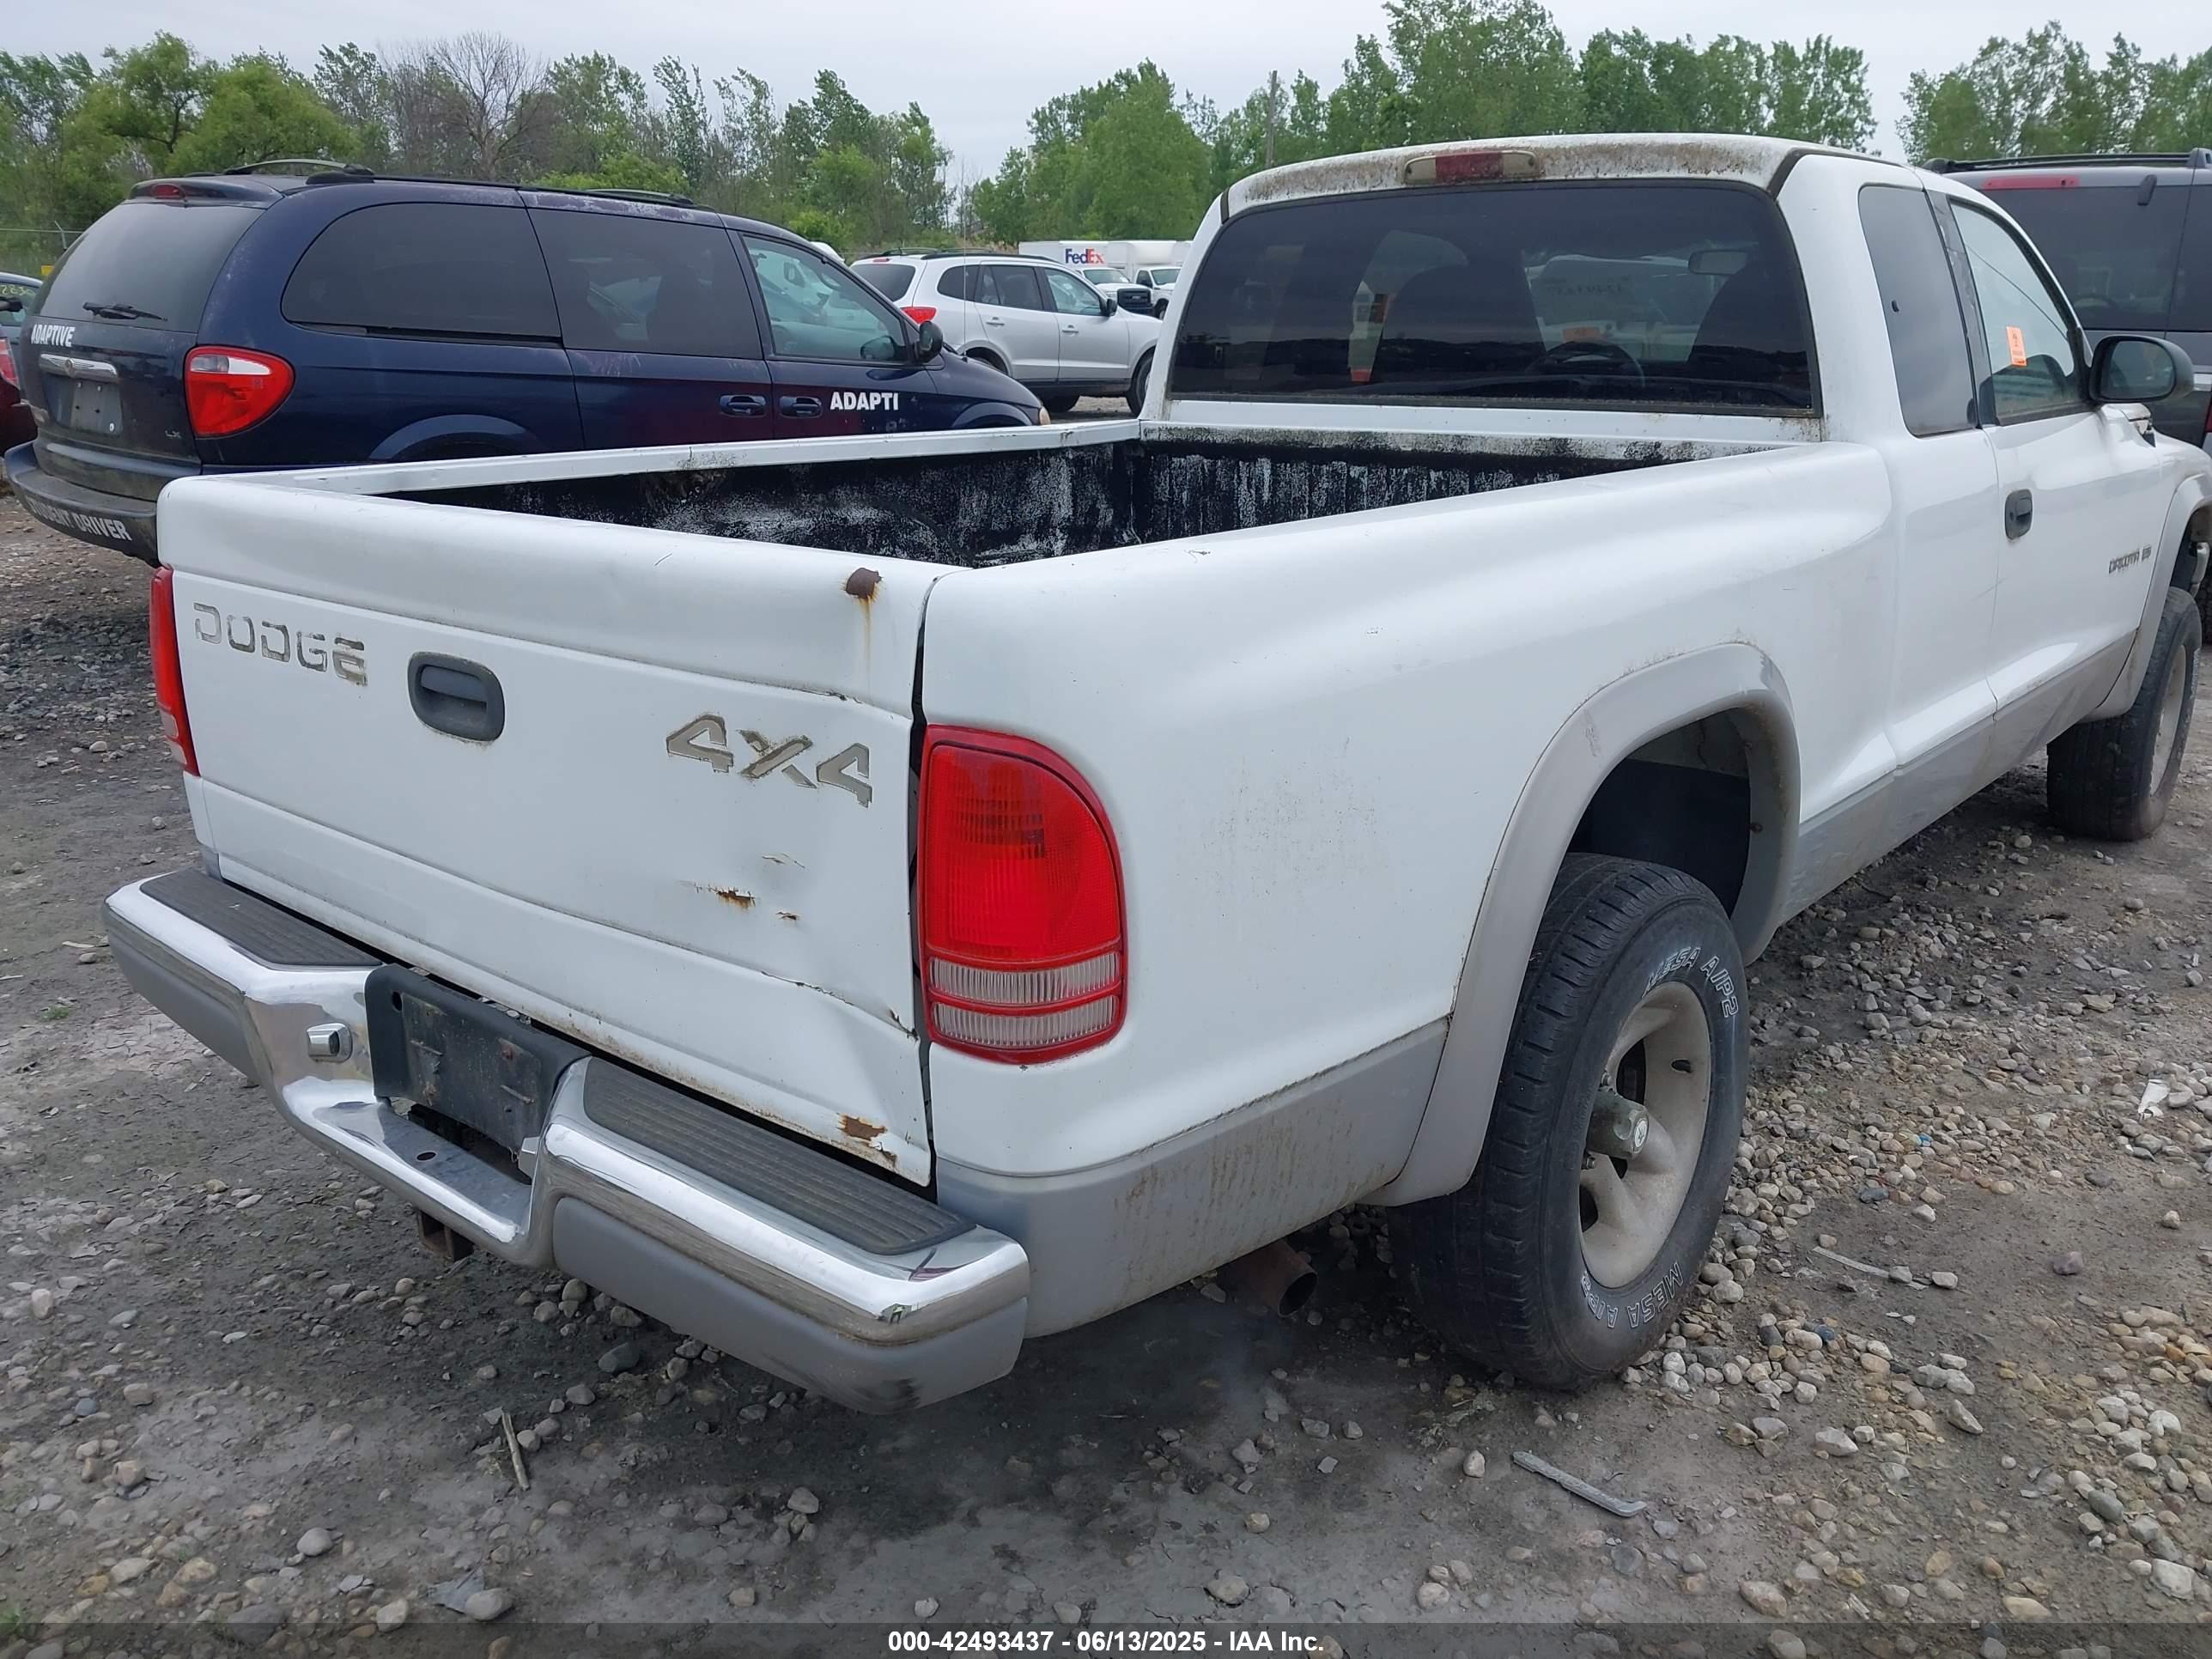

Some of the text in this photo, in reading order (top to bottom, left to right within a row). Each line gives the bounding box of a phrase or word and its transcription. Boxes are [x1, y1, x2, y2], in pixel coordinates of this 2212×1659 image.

[1065, 247, 1104, 264] FedEx
[31, 324, 76, 348] ADAPTIVE
[830, 391, 899, 410] ADAPTI
[71, 512, 133, 542] DRIVER
[193, 602, 368, 687] DODGE
[1626, 1261, 1684, 1328] MESA
